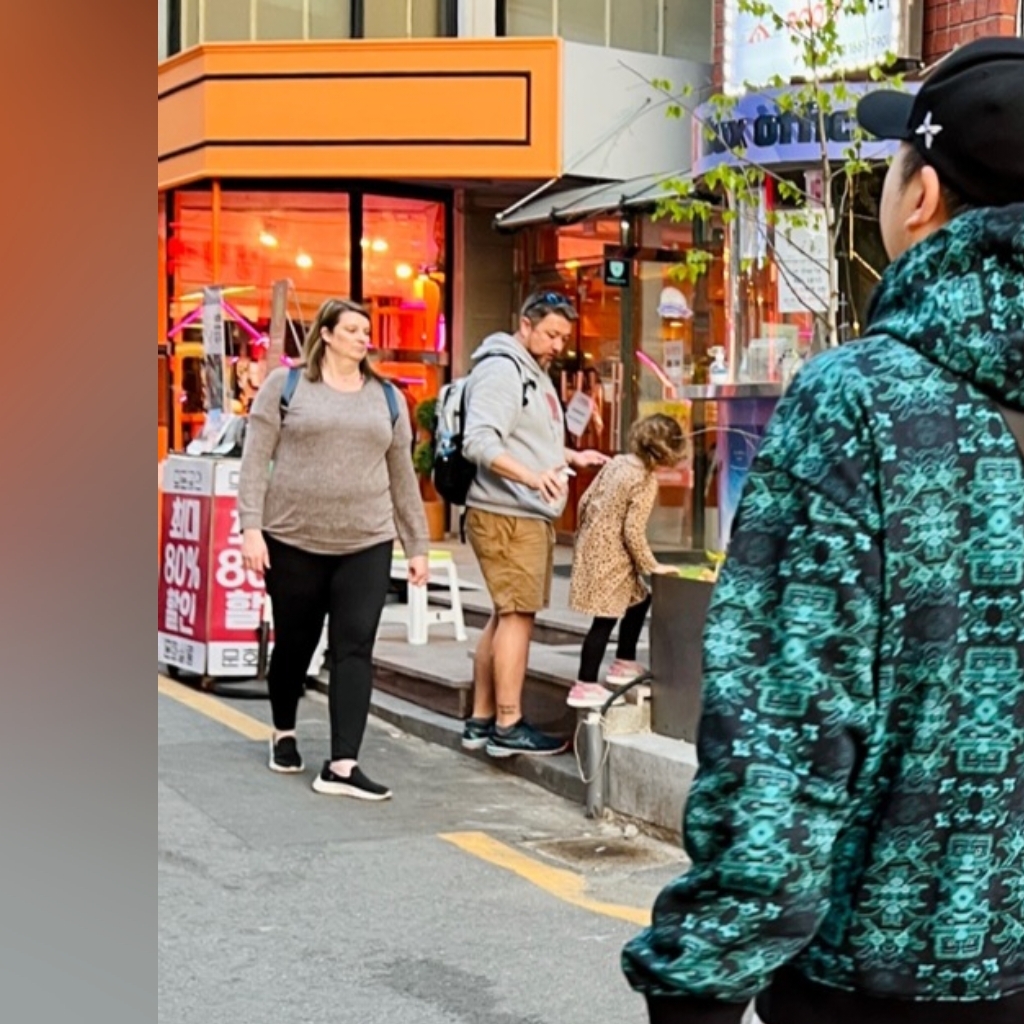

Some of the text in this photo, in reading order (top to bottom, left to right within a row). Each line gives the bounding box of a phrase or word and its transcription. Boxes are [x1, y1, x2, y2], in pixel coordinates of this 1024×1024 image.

[754, 102, 884, 148] offic
[169, 496, 201, 541] 최대
[164, 543, 201, 590] 80%
[164, 587, 197, 637] 할인
